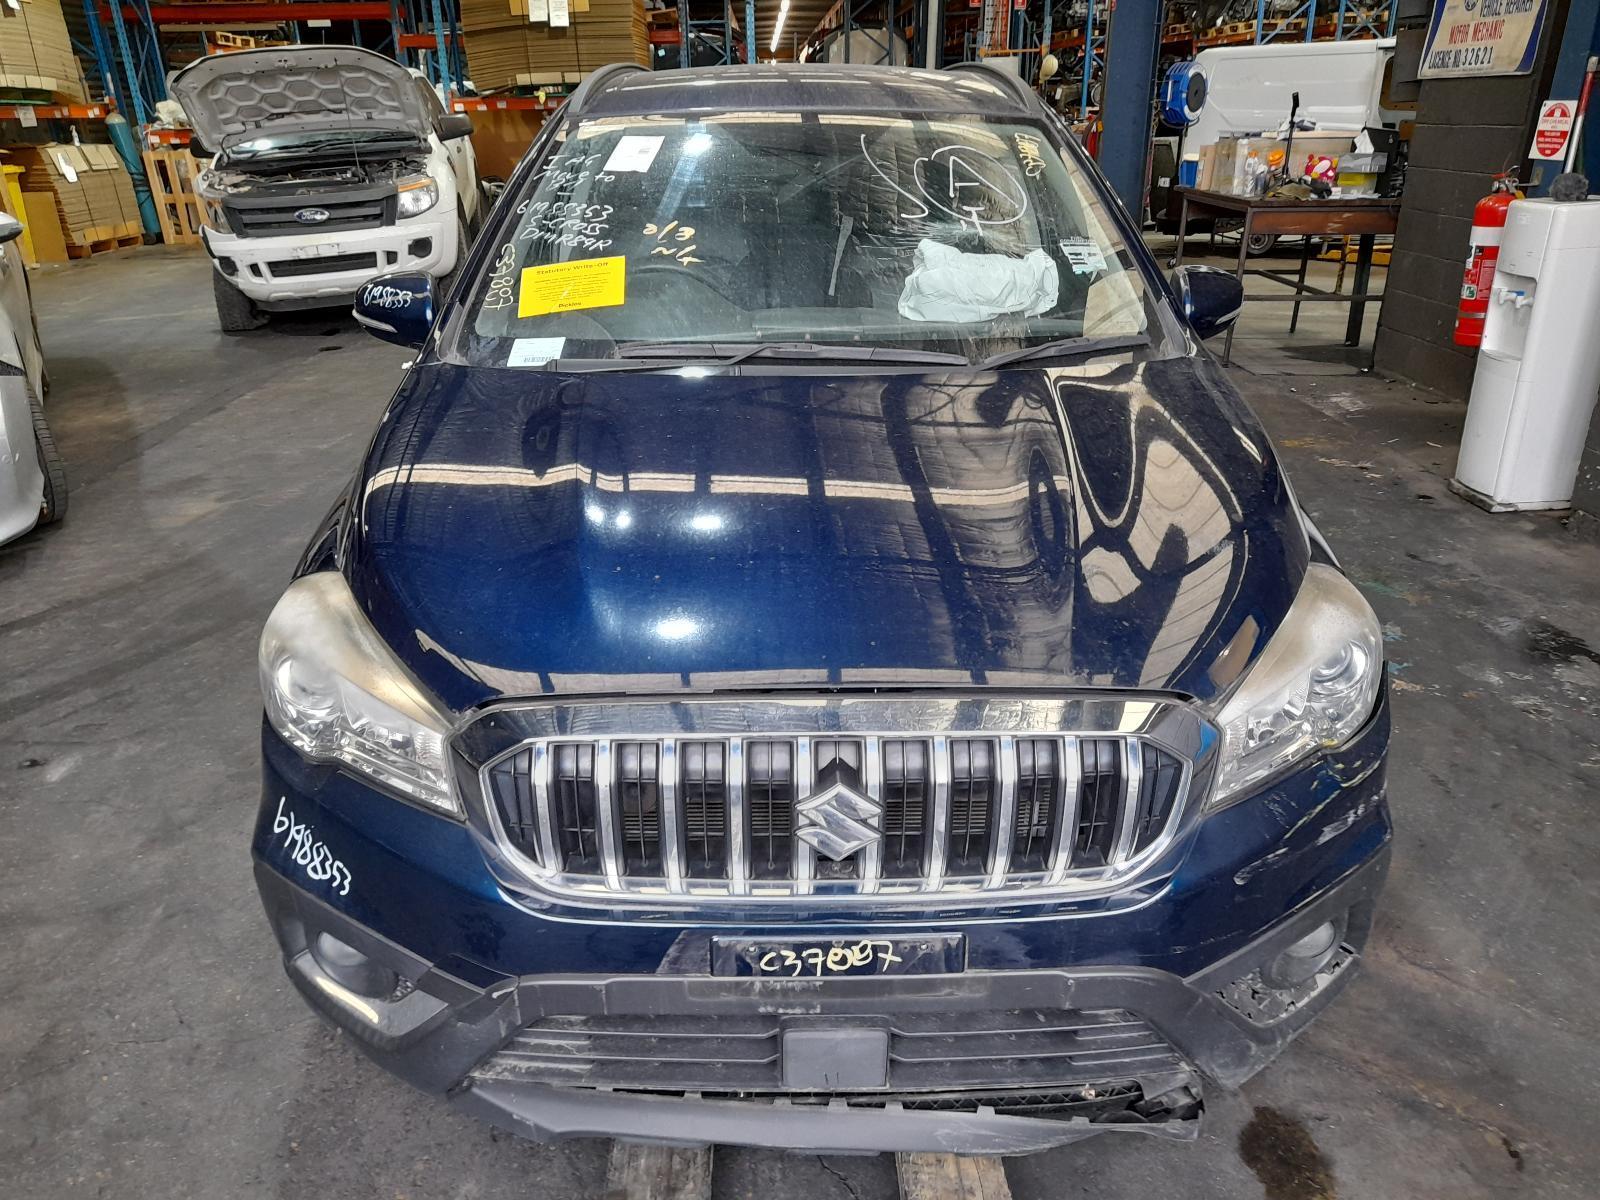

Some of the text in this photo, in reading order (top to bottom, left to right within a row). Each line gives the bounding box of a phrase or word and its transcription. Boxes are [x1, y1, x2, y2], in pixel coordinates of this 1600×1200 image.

[1448, 19, 1505, 45] MOTOR MECHANIC
[1462, 46, 1494, 66] 32621
